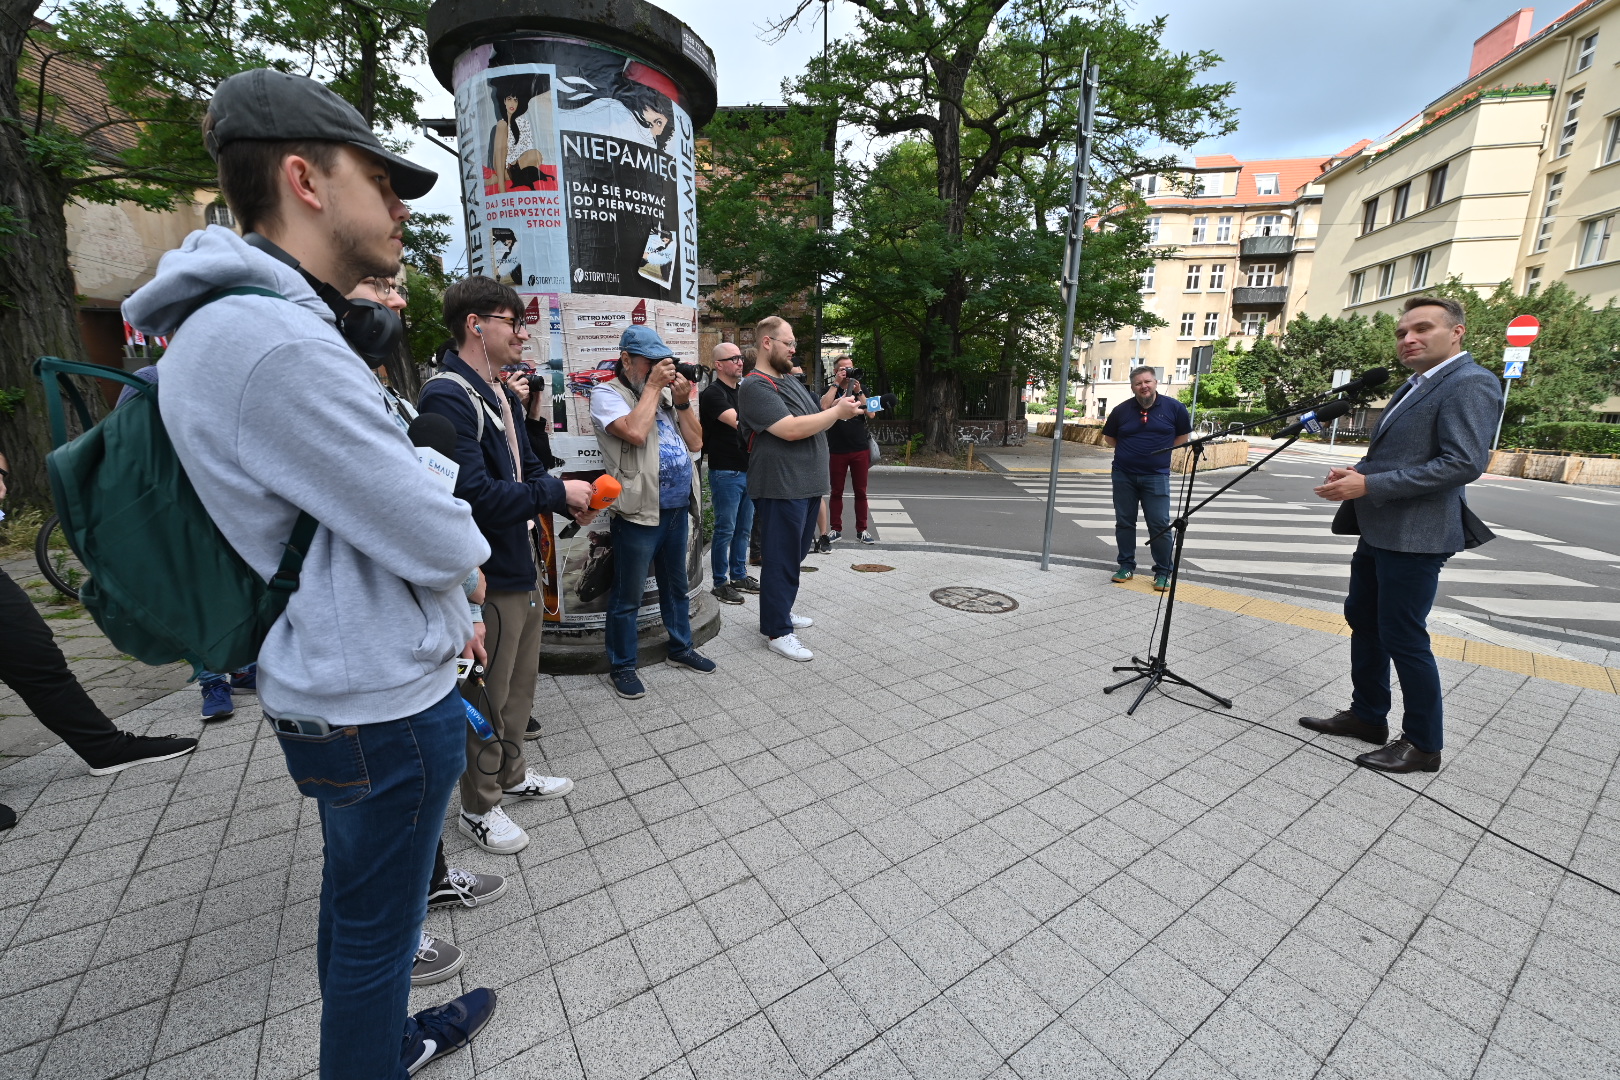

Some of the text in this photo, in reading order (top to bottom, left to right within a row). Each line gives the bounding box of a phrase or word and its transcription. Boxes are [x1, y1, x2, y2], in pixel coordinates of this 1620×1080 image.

[563, 135, 677, 182] NIEPAMIĘĆ
[486, 195, 560, 211] DAJ SIĘ PORWAĆ
[573, 181, 666, 208] DAJ SIĘ PORWAĆ
[486, 208, 561, 221] OD PIERWSZYCH
[574, 195, 664, 220] OD PIERWSZYCH
[574, 208, 617, 223] STRON
[680, 114, 696, 301] NIEPAMIĘĆ
[527, 219, 561, 228] STRON
[536, 276, 565, 285] STORYLIGHT
[584, 271, 620, 283] STORYLIGHT
[428, 459, 455, 479] EMAUS
[466, 705, 485, 725] EMAUS
